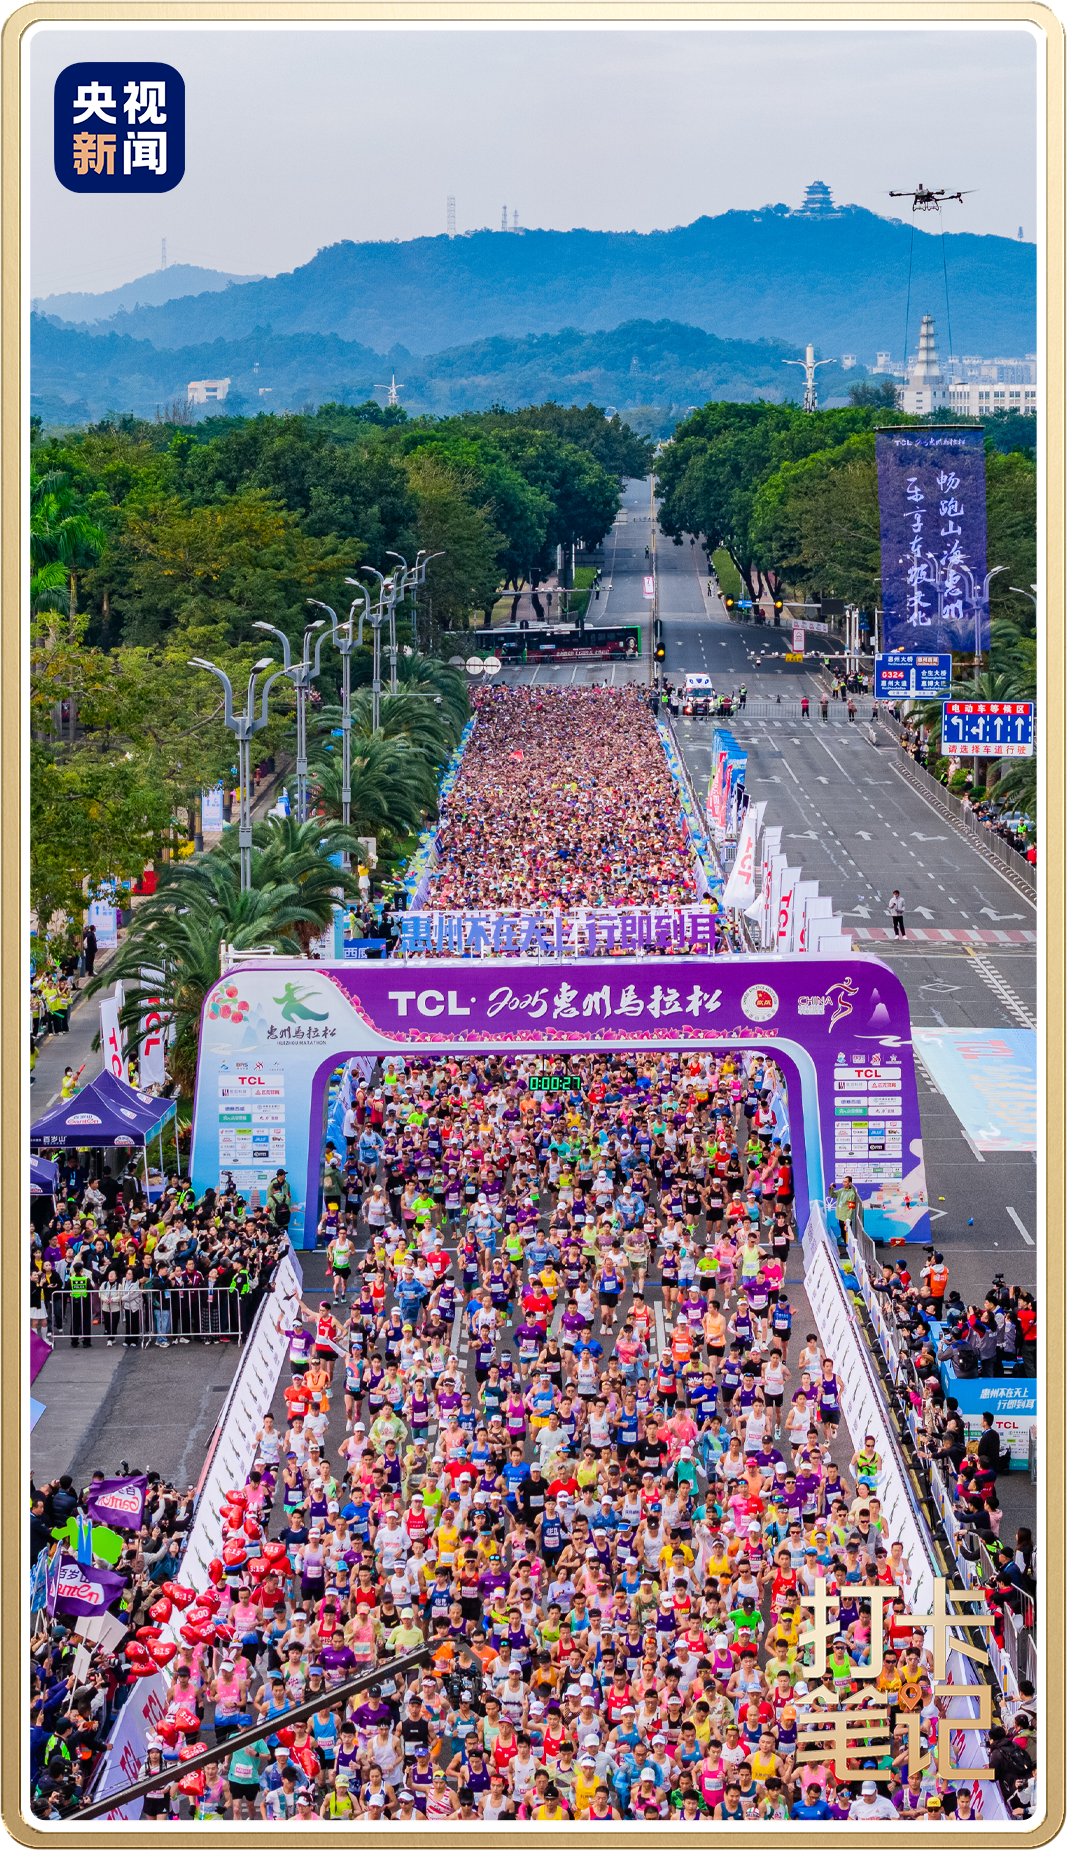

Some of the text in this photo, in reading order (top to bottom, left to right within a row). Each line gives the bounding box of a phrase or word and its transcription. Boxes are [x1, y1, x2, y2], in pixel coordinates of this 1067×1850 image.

[936, 470, 964, 620] 畅跑山海惠州
[951, 703, 1025, 714] 电动车等候区
[948, 744, 1027, 755] 请选择车道行驶
[486, 986, 549, 1019] 2025
[797, 995, 834, 1006] CHINA
[854, 1069, 882, 1078] TCL
[238, 1076, 265, 1085] TCL
[530, 1077, 581, 1090] 0:00:27
[43, 1135, 67, 1143] 百岁山
[980, 1387, 1029, 1399] 惠州不在天上
[997, 1398, 1037, 1411] 行即到耳
[995, 1421, 1019, 1429] TCL
[174, 1591, 193, 1602] 6:15
[150, 1602, 167, 1618] 6:15
[189, 1609, 209, 1622] 3:00
[200, 1623, 216, 1637] 3:00
[153, 1647, 170, 1656] 3:15
[179, 1710, 196, 1727] 3:15
